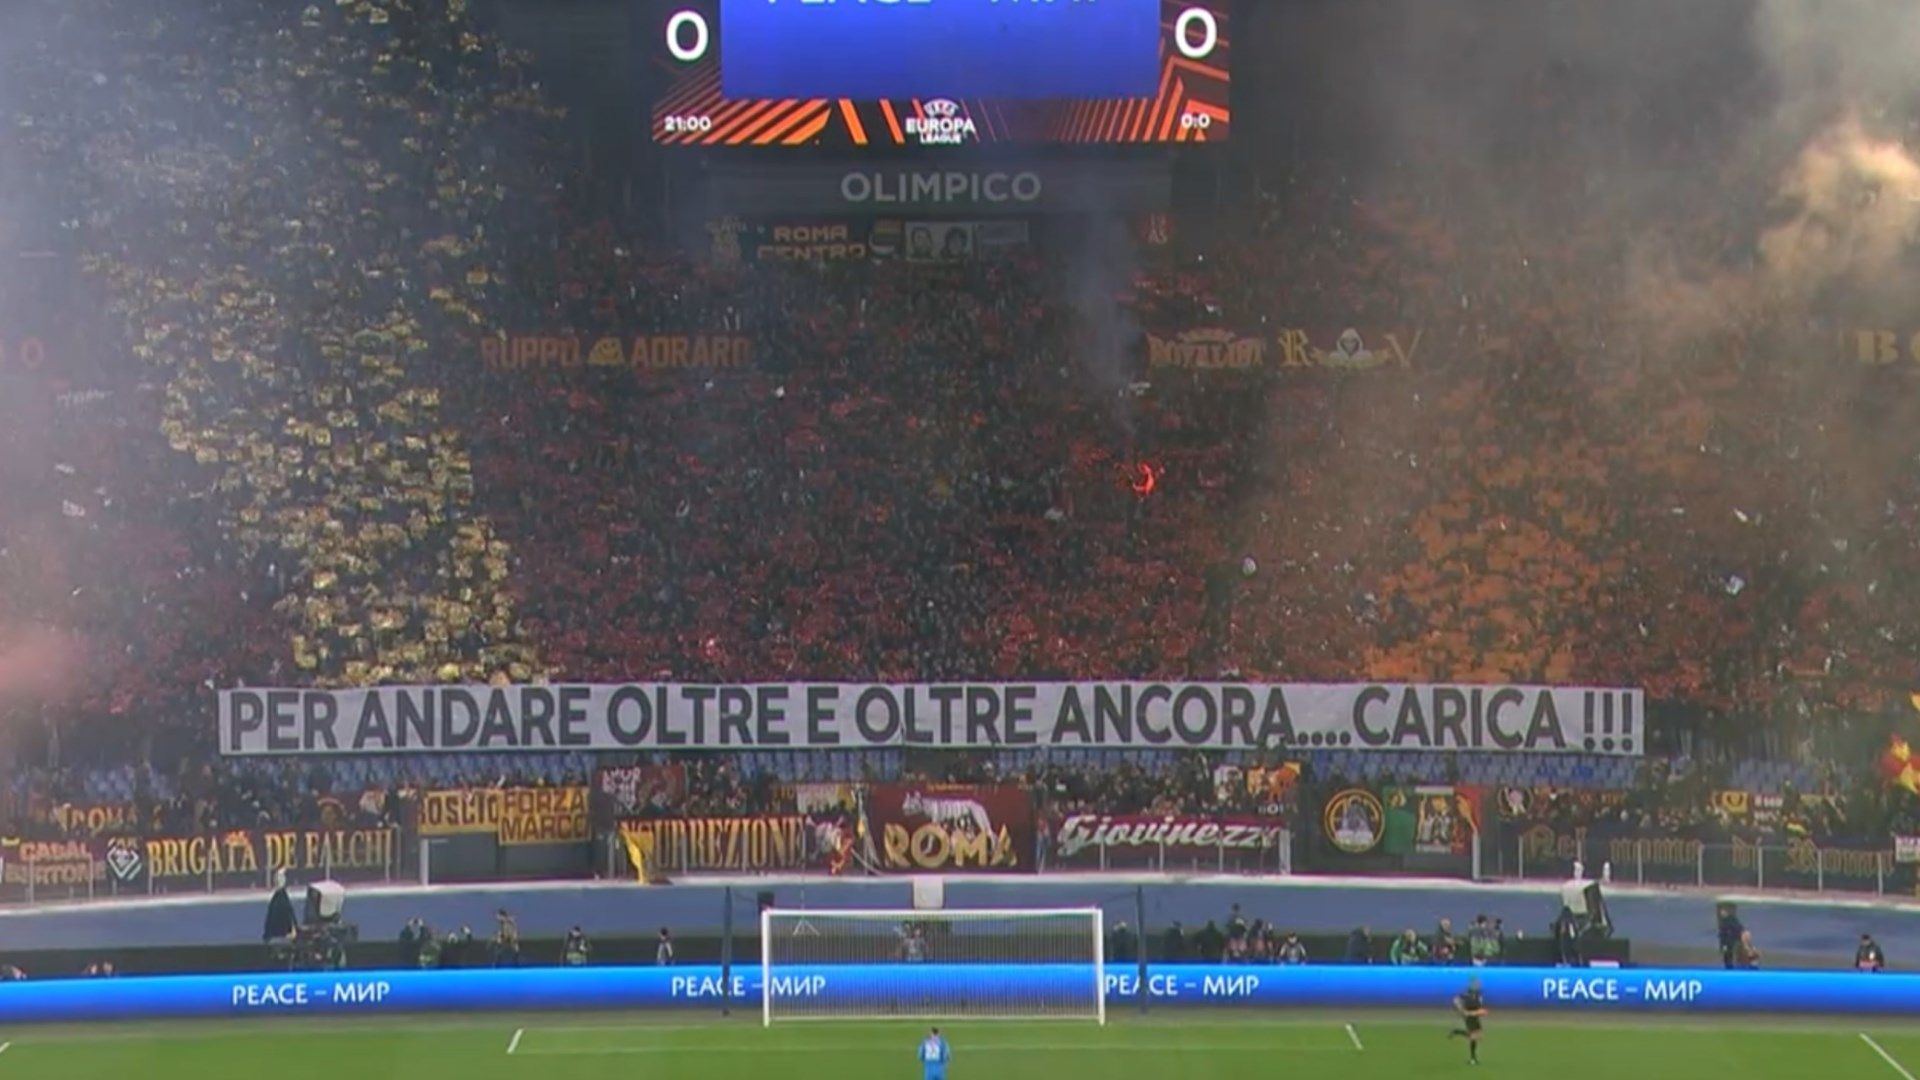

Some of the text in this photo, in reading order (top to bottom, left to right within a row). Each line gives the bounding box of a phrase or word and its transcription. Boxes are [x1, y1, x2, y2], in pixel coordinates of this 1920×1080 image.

[665, 11, 709, 61] 0
[1174, 7, 1218, 58] 0
[664, 116, 712, 132] 21:00
[905, 117, 976, 138] EUROPA
[1181, 112, 1210, 130] 0:0
[919, 132, 962, 145] LEAGUE
[840, 172, 1042, 203] OLIMPICO
[773, 224, 848, 242] ROMA
[230, 691, 338, 752] PER
[352, 687, 592, 750] ANDARE
[606, 684, 791, 747] OLTRE
[806, 685, 840, 744] E
[854, 684, 1036, 746] OLTRE
[504, 789, 585, 814] FORZA
[147, 828, 392, 878] BRIGATA DE FALCHI
[884, 822, 1018, 868] ROMA
[233, 984, 308, 1006] PEACE
[333, 982, 390, 1003] МИР
[770, 975, 826, 996] МИР
[1203, 975, 1259, 996] МИР
[1543, 978, 1619, 1000] PEACE
[1645, 979, 1702, 1001] МИР
